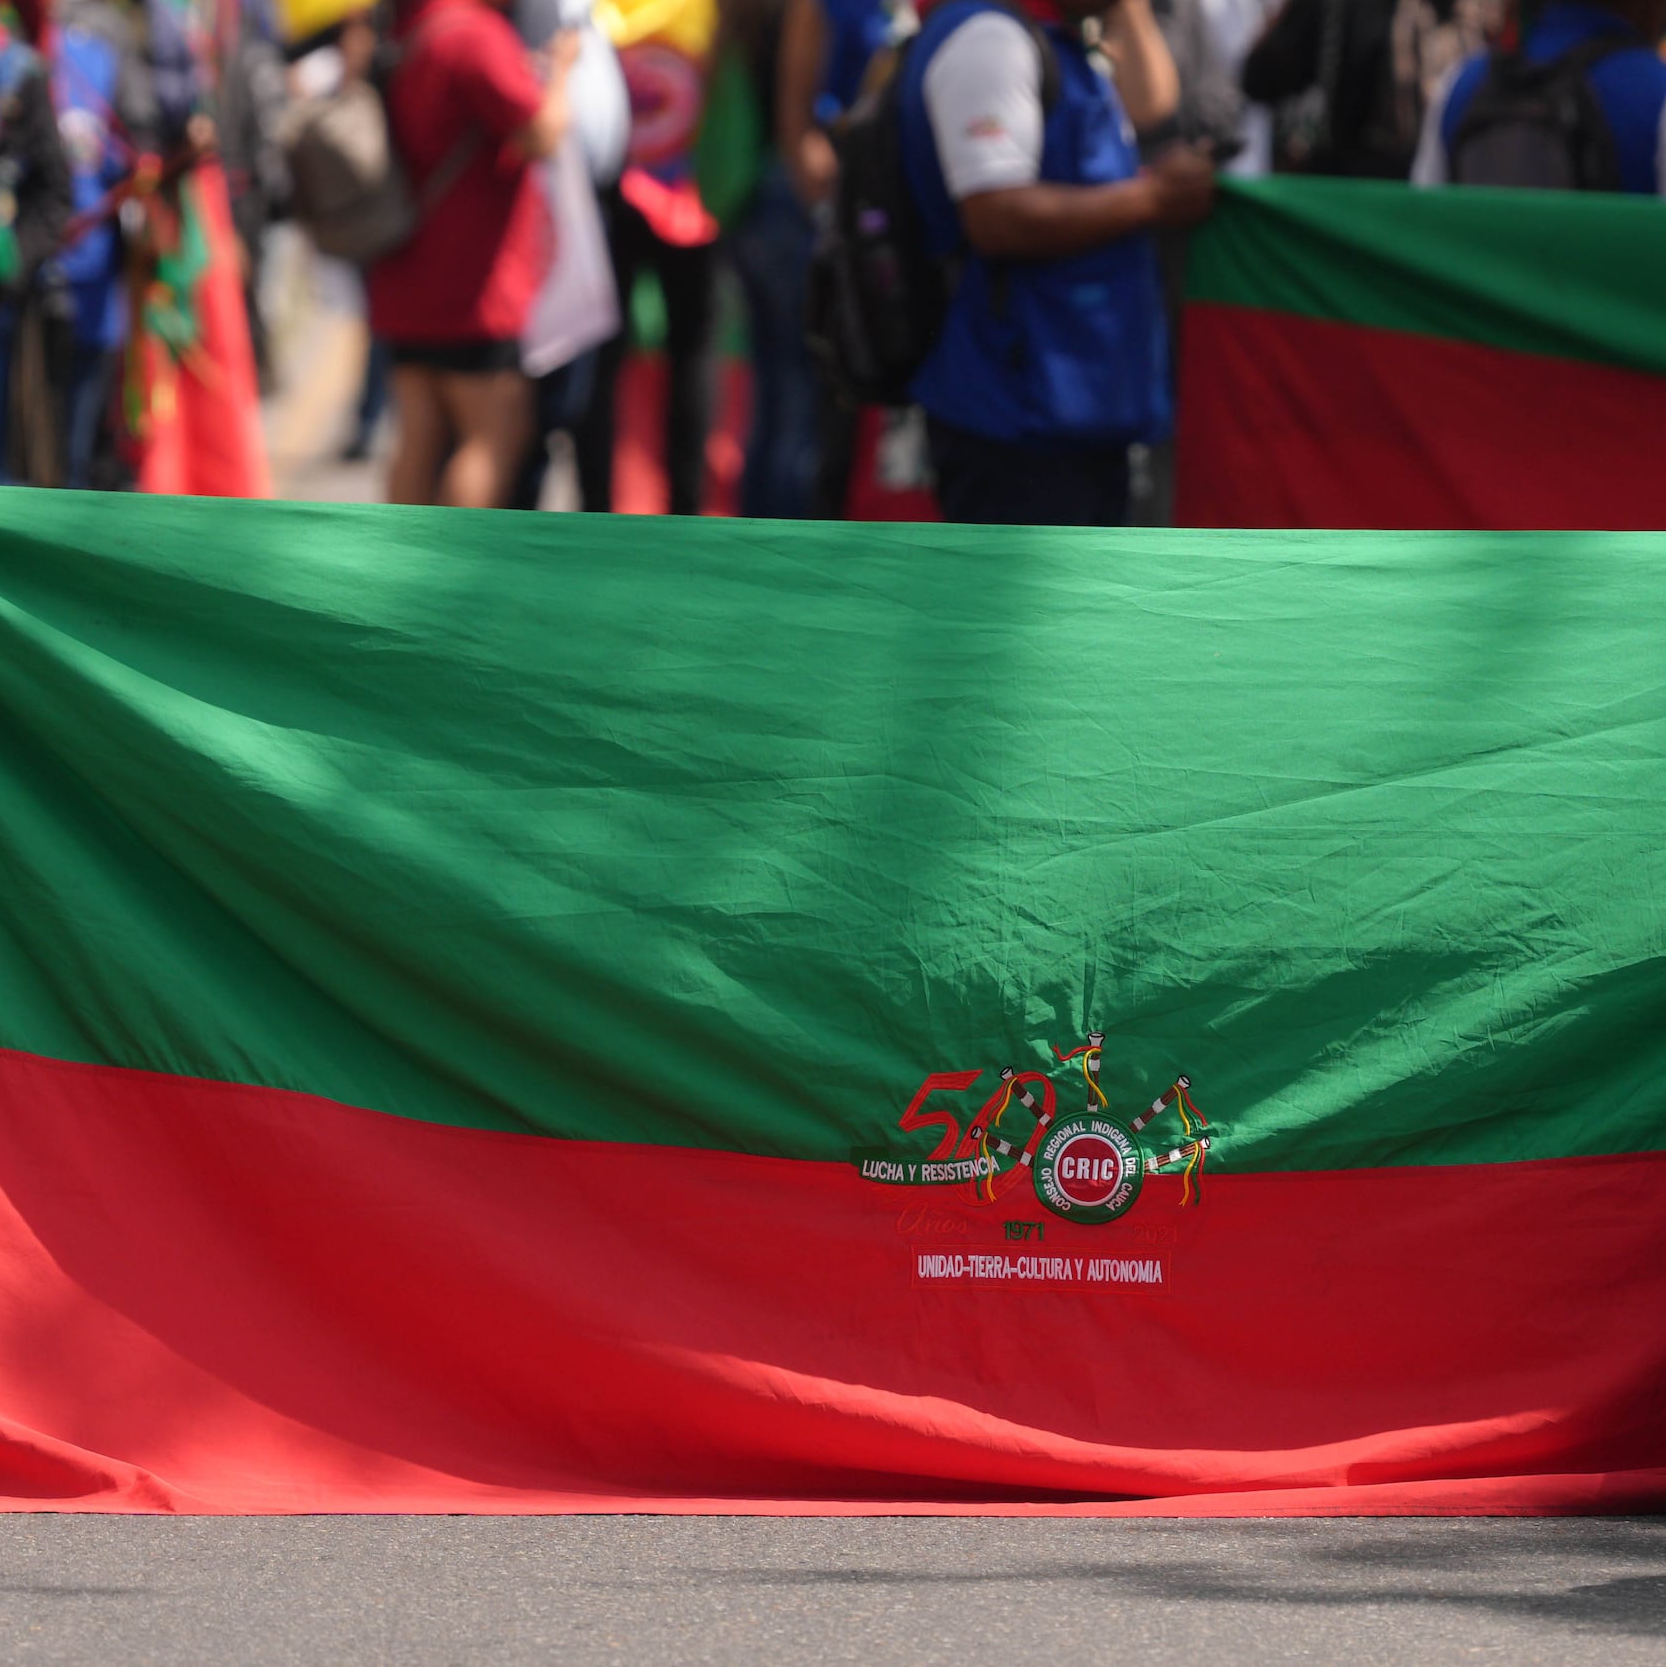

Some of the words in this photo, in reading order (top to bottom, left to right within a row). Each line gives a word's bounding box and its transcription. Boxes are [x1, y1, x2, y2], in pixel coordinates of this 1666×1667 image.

[897, 1069, 1057, 1207] 50
[1043, 1120, 1086, 1161] REGIONAL
[1091, 1120, 1133, 1155] INDIGENA
[861, 1159, 904, 1182] LUCHA
[908, 1164, 918, 1182] Y
[921, 1155, 1001, 1183] RESISTENCIA
[1061, 1156, 1114, 1181] CRIC
[1124, 1156, 1136, 1178] DEL
[1040, 1167, 1071, 1211] CONSEJO
[1105, 1182, 1133, 1211] CAUCA
[1002, 1220, 1045, 1242] 1971
[917, 1254, 1073, 1281] UNIDAD-TIERRA-CULTURA
[1074, 1258, 1084, 1281] Y
[1086, 1259, 1163, 1284] AUTONOMIA
